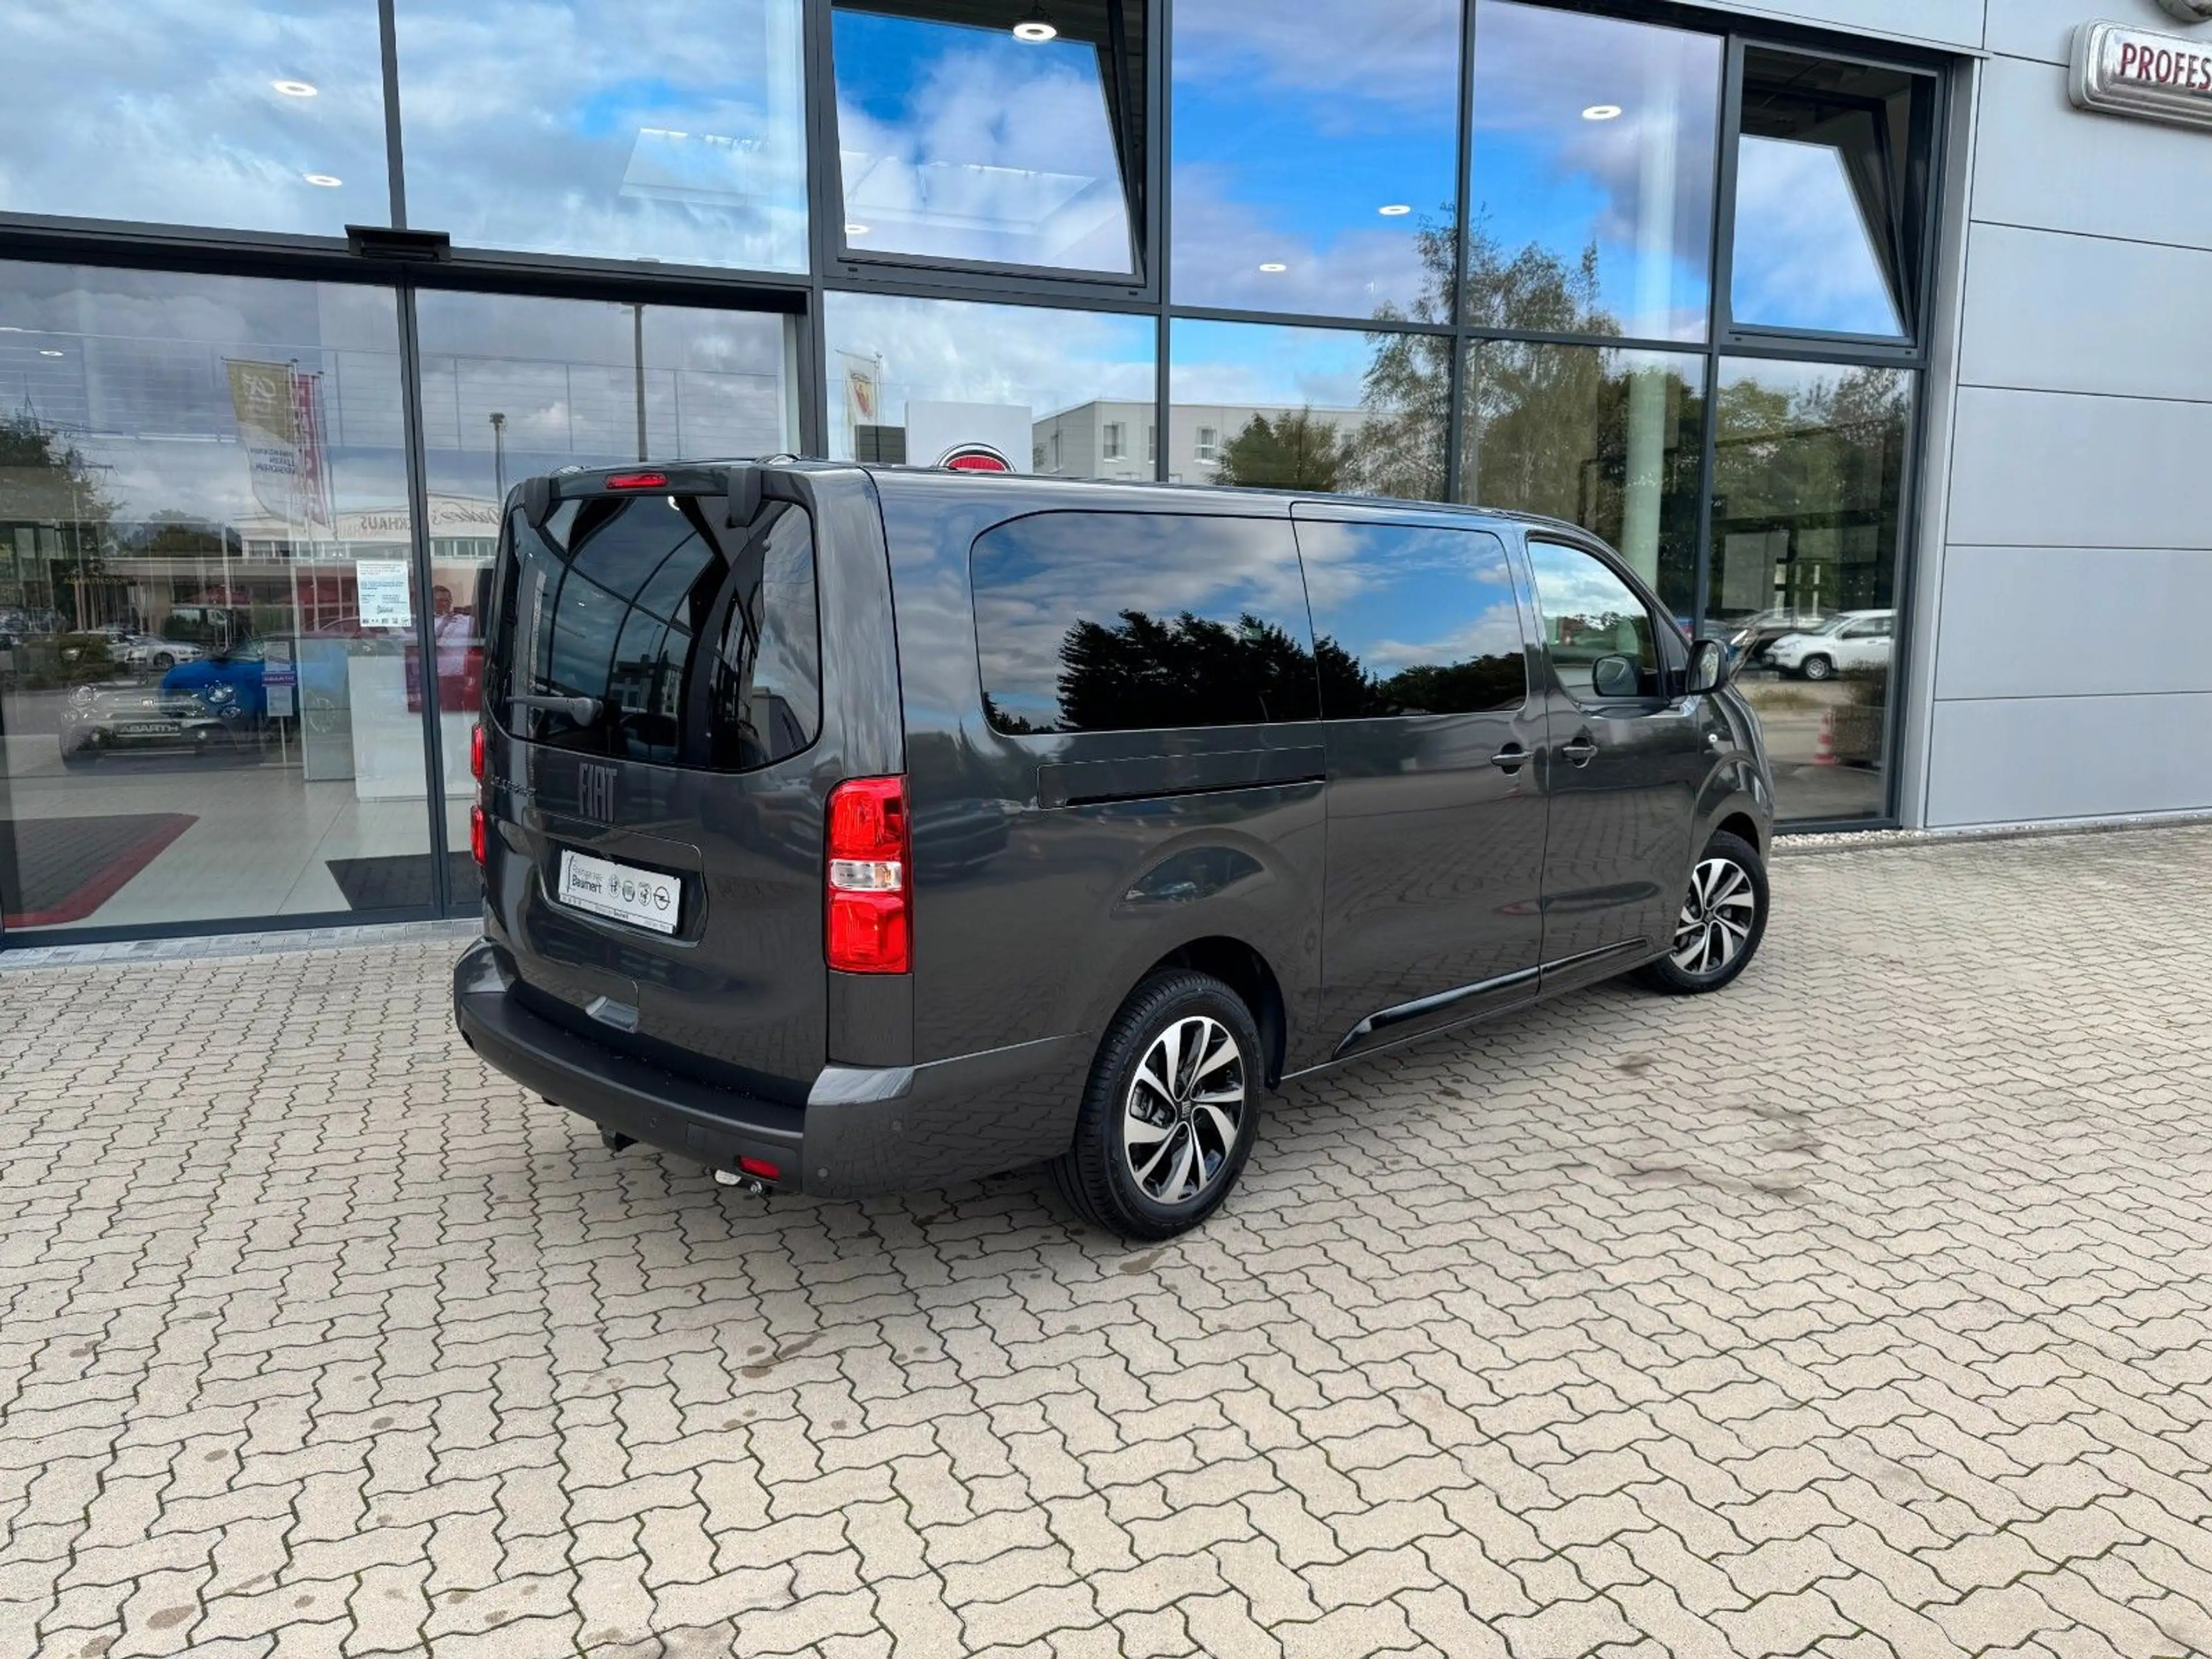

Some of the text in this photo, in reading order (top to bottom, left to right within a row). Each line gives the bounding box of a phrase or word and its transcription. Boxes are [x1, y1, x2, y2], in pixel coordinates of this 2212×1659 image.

[2119, 43, 2212, 90] PROFES
[120, 724, 180, 733] ABARTH
[578, 762, 618, 823] FIAT
[571, 874, 603, 894] Baumert
